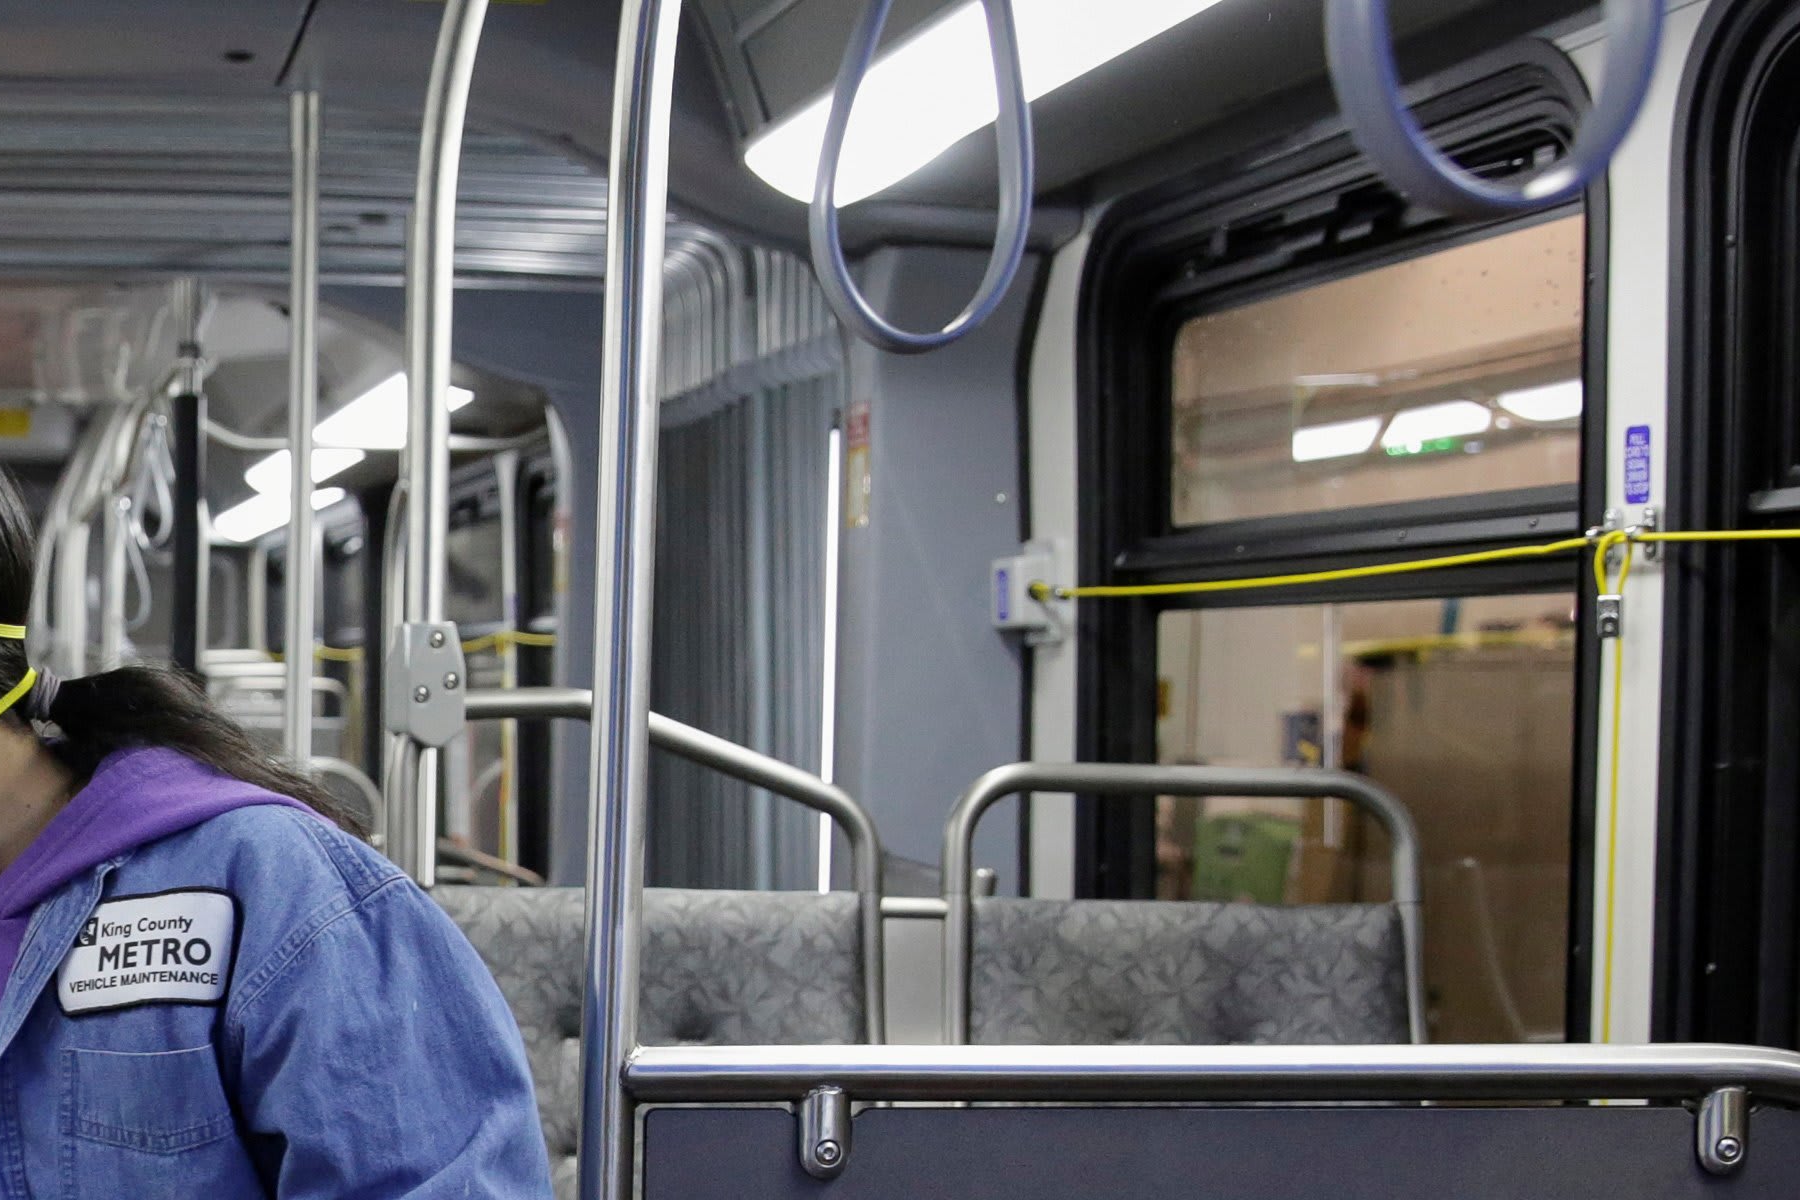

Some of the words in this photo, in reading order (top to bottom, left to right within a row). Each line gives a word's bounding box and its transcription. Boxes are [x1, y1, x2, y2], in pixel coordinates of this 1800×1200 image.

[101, 922, 132, 938] King
[137, 915, 193, 933] County
[98, 938, 212, 972] METRO
[70, 976, 117, 993] VEHICLE
[120, 971, 219, 986] MAINTENANCE
